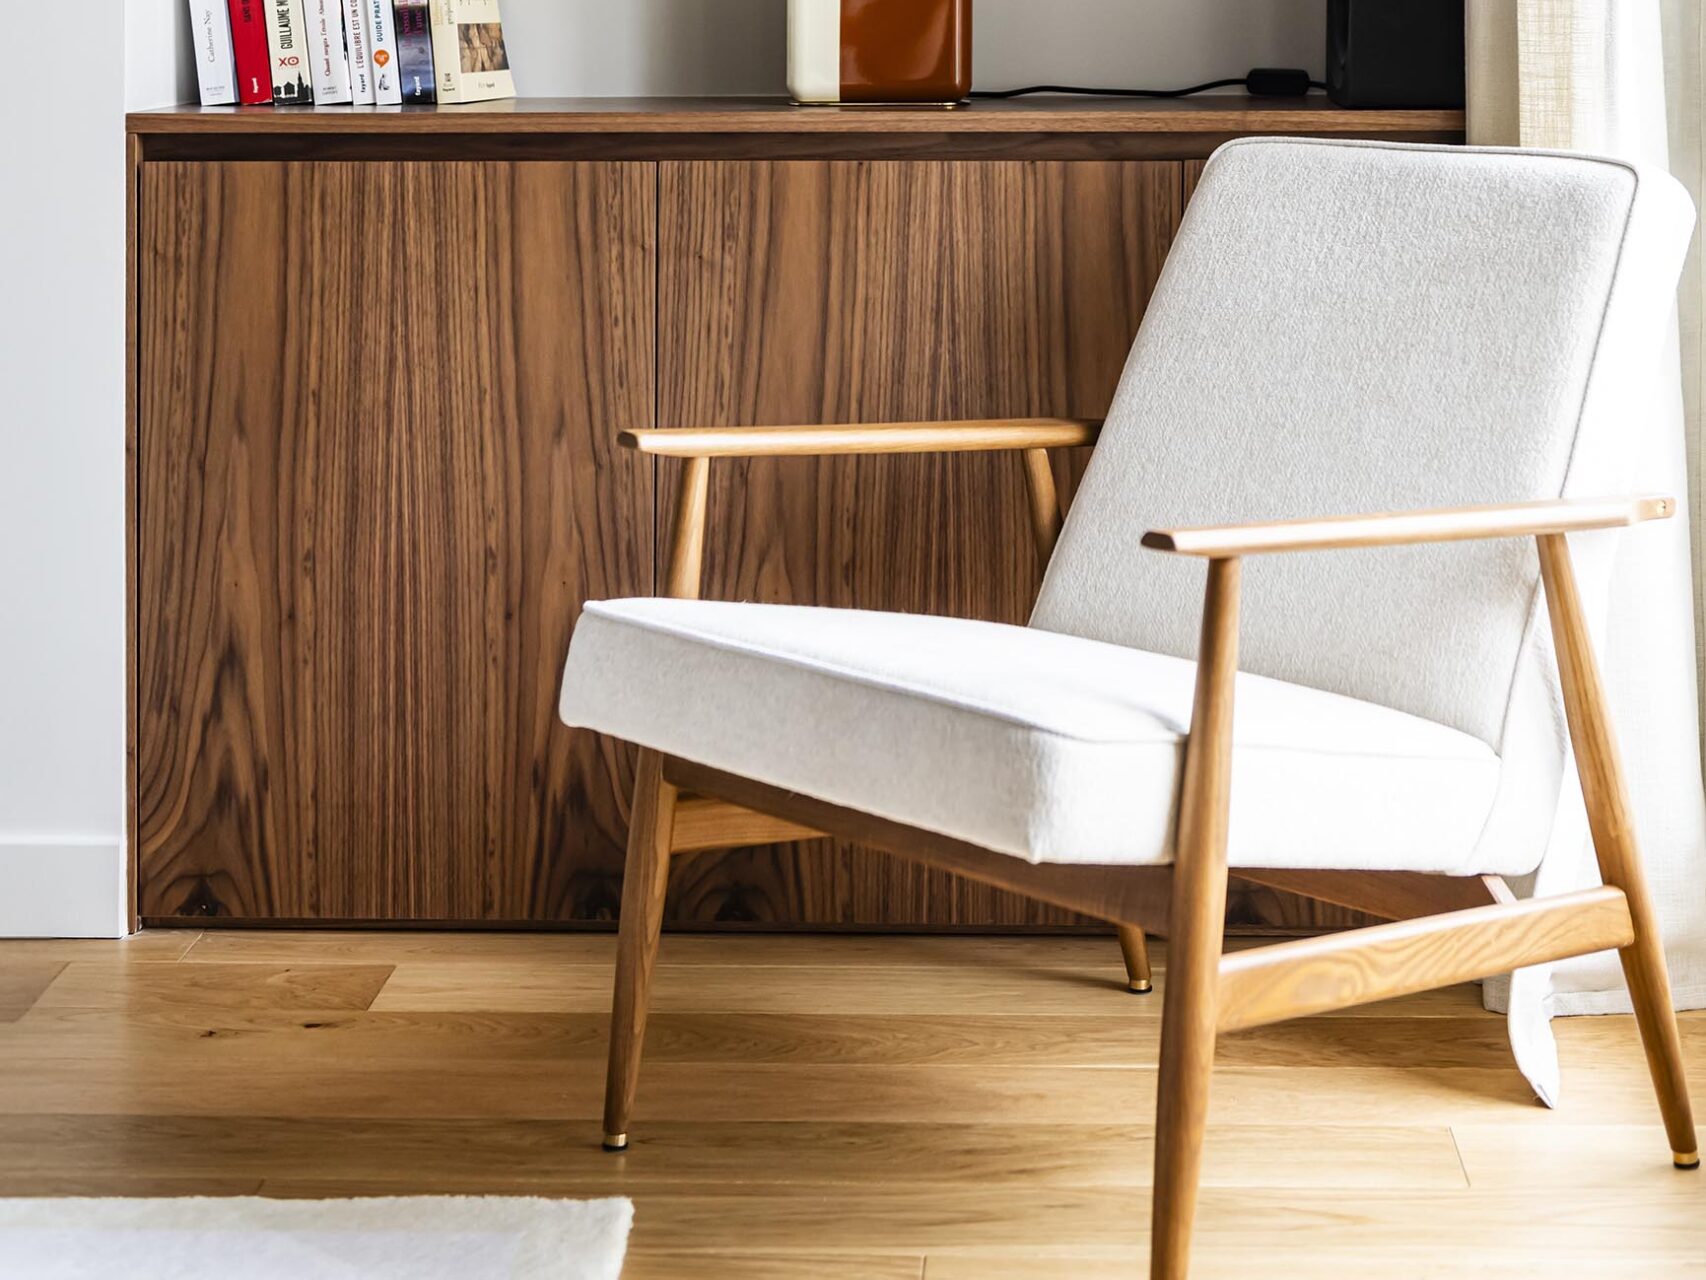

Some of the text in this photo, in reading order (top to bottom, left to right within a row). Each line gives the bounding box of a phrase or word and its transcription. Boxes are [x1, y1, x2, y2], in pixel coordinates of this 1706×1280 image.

[350, 8, 359, 18] UN
[278, 9, 293, 51] GUILLAUME
[351, 19, 361, 31] EST
[374, 20, 384, 43] GUIDE
[203, 10, 217, 64] Catherine Nay
[353, 31, 365, 70] L'ÉQUILIBRE
[322, 58, 332, 77] Quand
